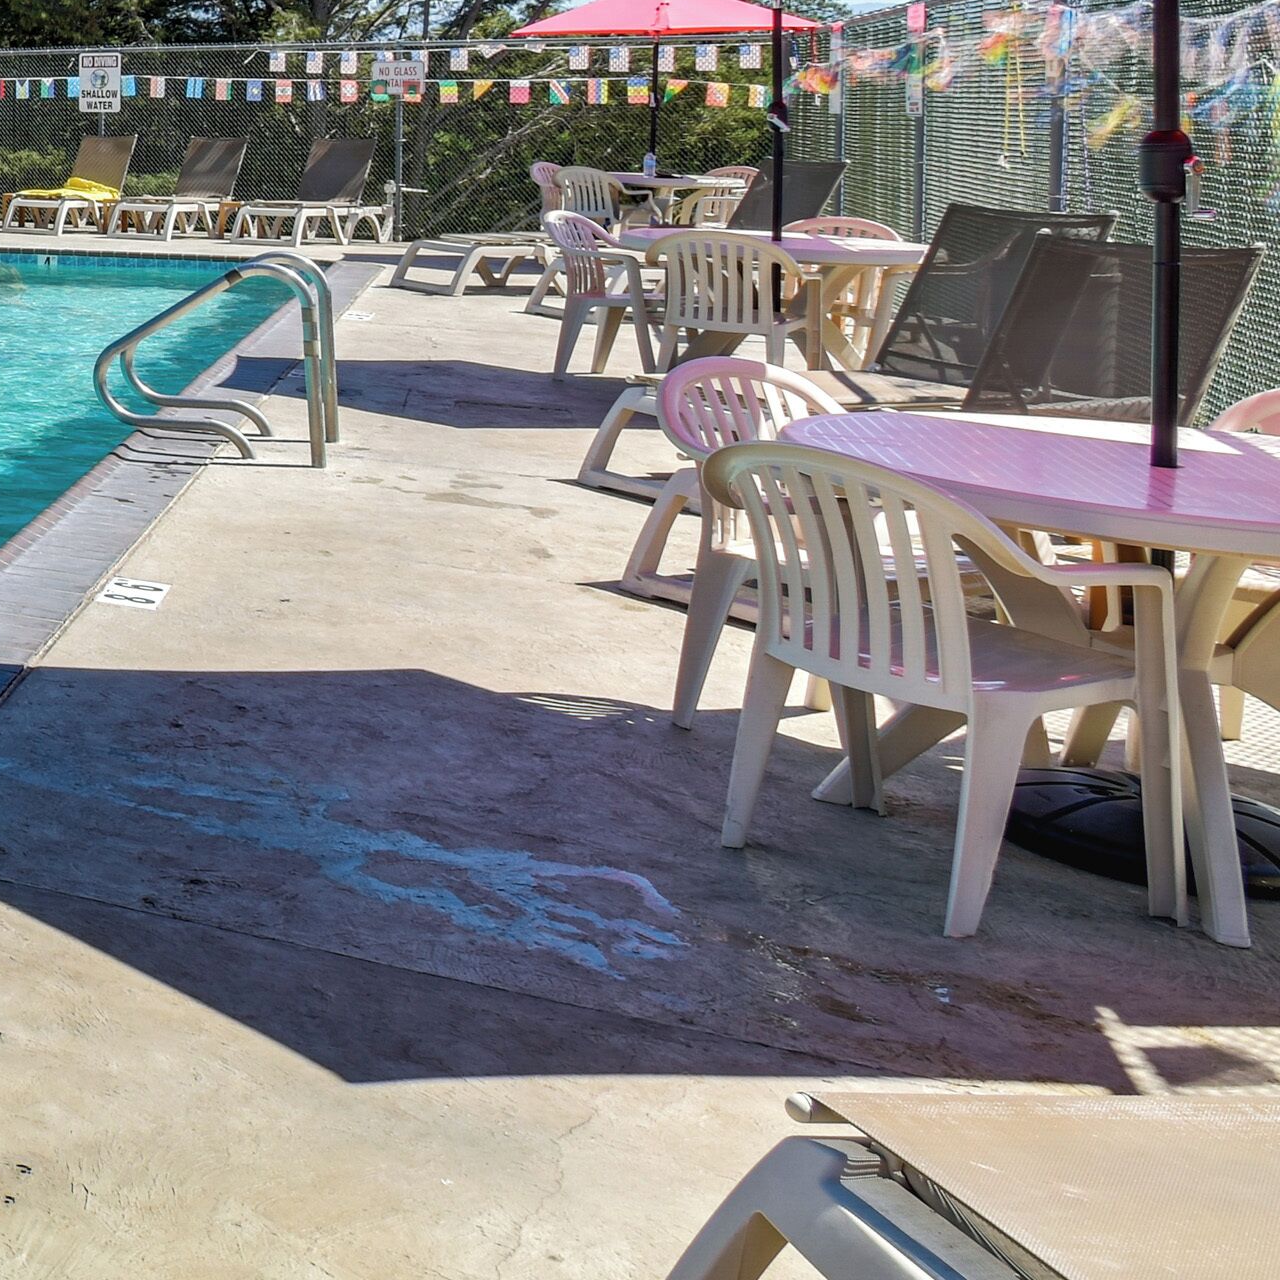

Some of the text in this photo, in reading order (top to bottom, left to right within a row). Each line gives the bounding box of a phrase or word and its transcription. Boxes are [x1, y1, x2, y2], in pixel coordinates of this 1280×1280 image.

[82, 56, 117, 67] NO DIVING
[378, 66, 417, 76] NO GLASS
[81, 89, 118, 99] SHALLOW
[86, 101, 113, 110] WATER
